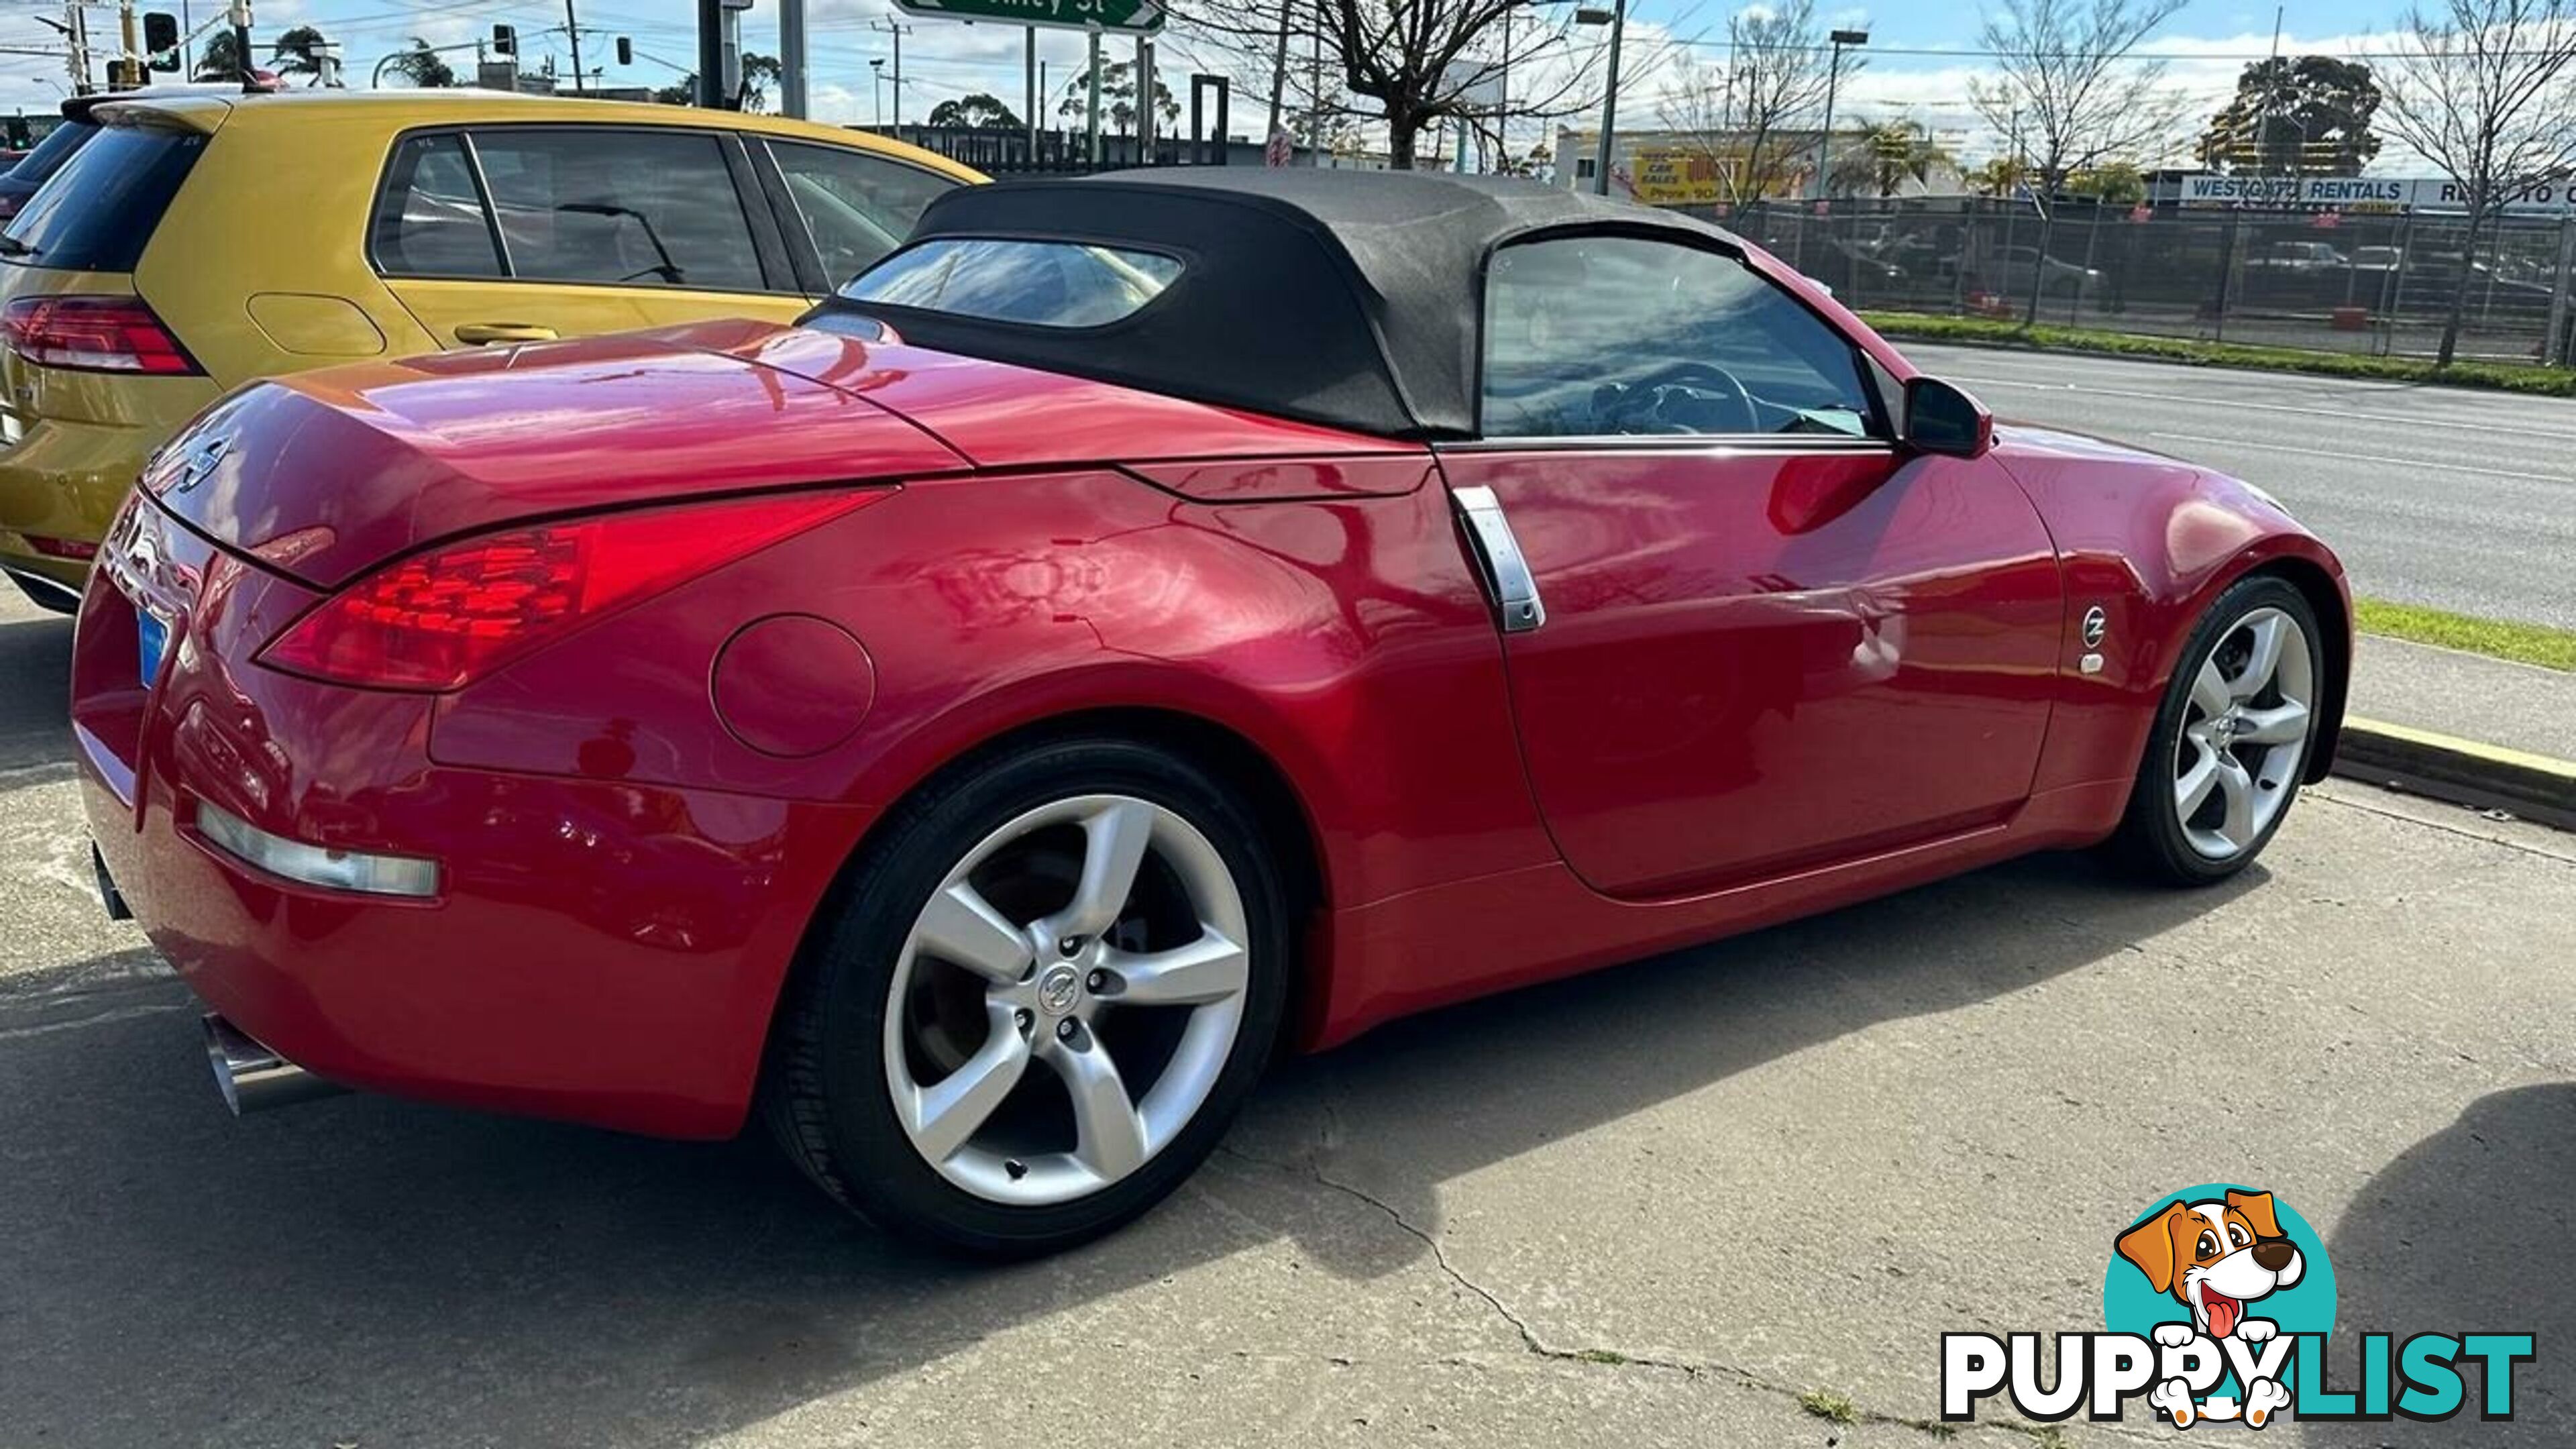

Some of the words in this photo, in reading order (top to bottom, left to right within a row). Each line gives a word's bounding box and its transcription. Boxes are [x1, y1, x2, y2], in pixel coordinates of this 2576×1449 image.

[1648, 164, 1674, 173] CAR
[2311, 181, 2400, 200] RENTALS
[2087, 617, 2105, 637] Z
